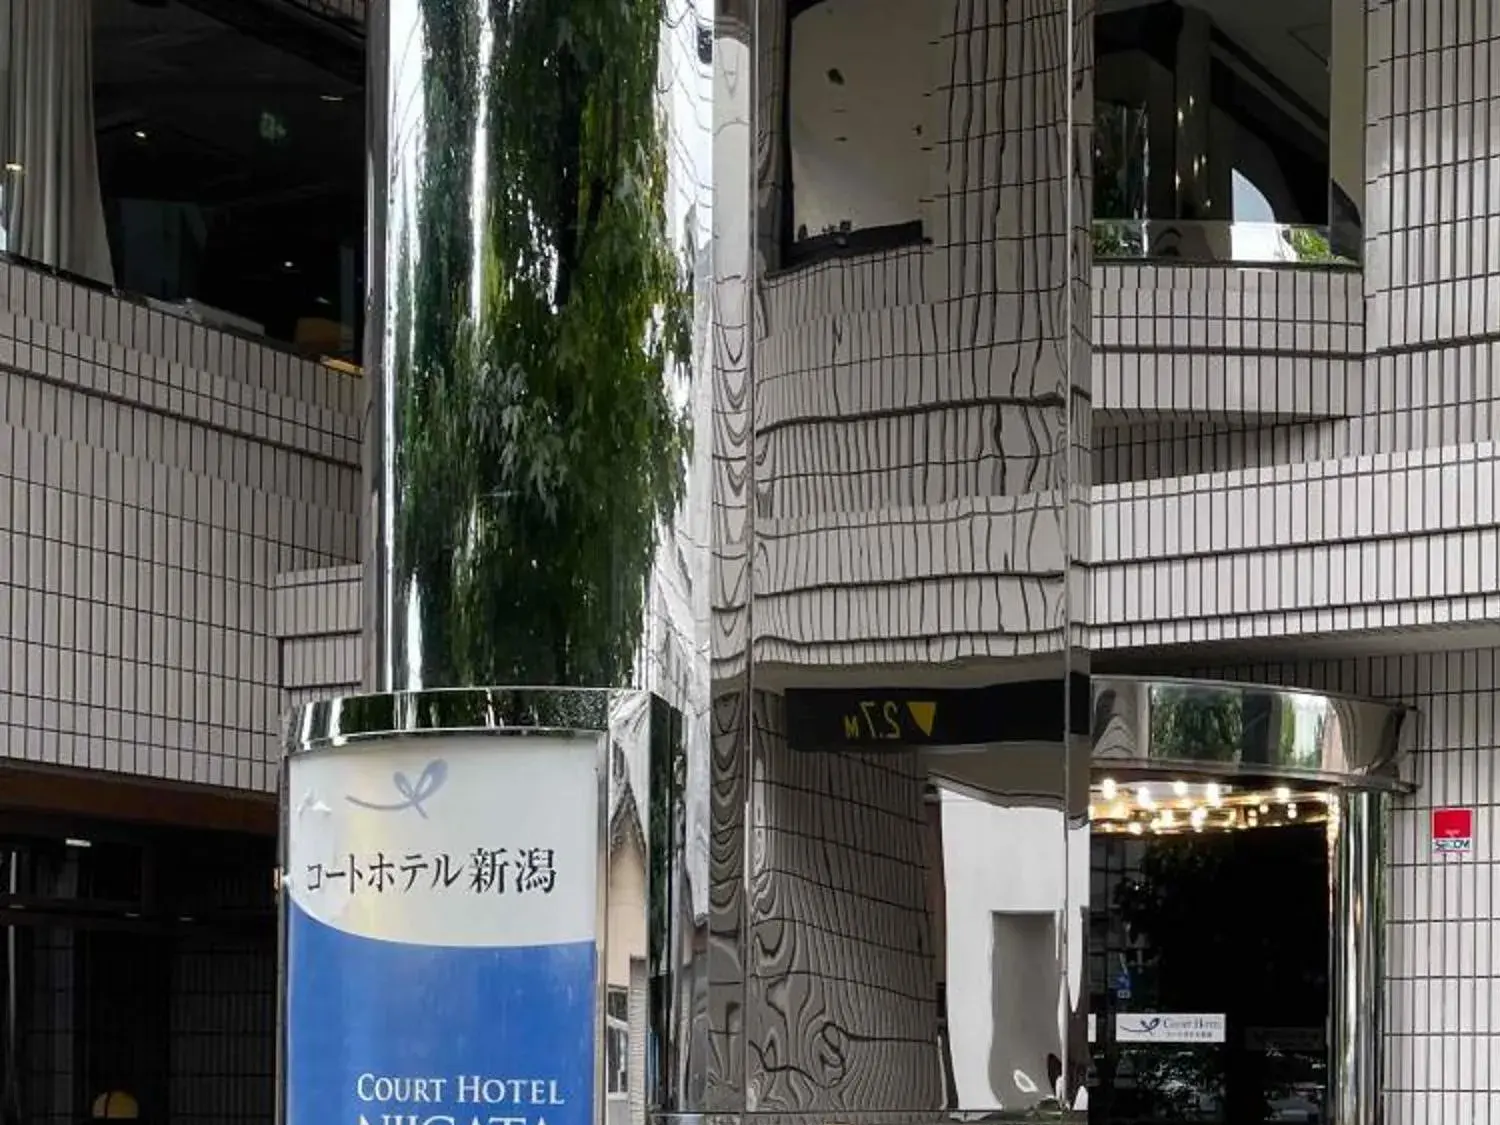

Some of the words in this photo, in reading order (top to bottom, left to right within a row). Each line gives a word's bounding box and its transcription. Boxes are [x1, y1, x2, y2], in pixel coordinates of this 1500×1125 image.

[306, 847, 558, 894] コートホテル新潟
[356, 1073, 447, 1102] COURT
[457, 1075, 565, 1105] HOTEL
